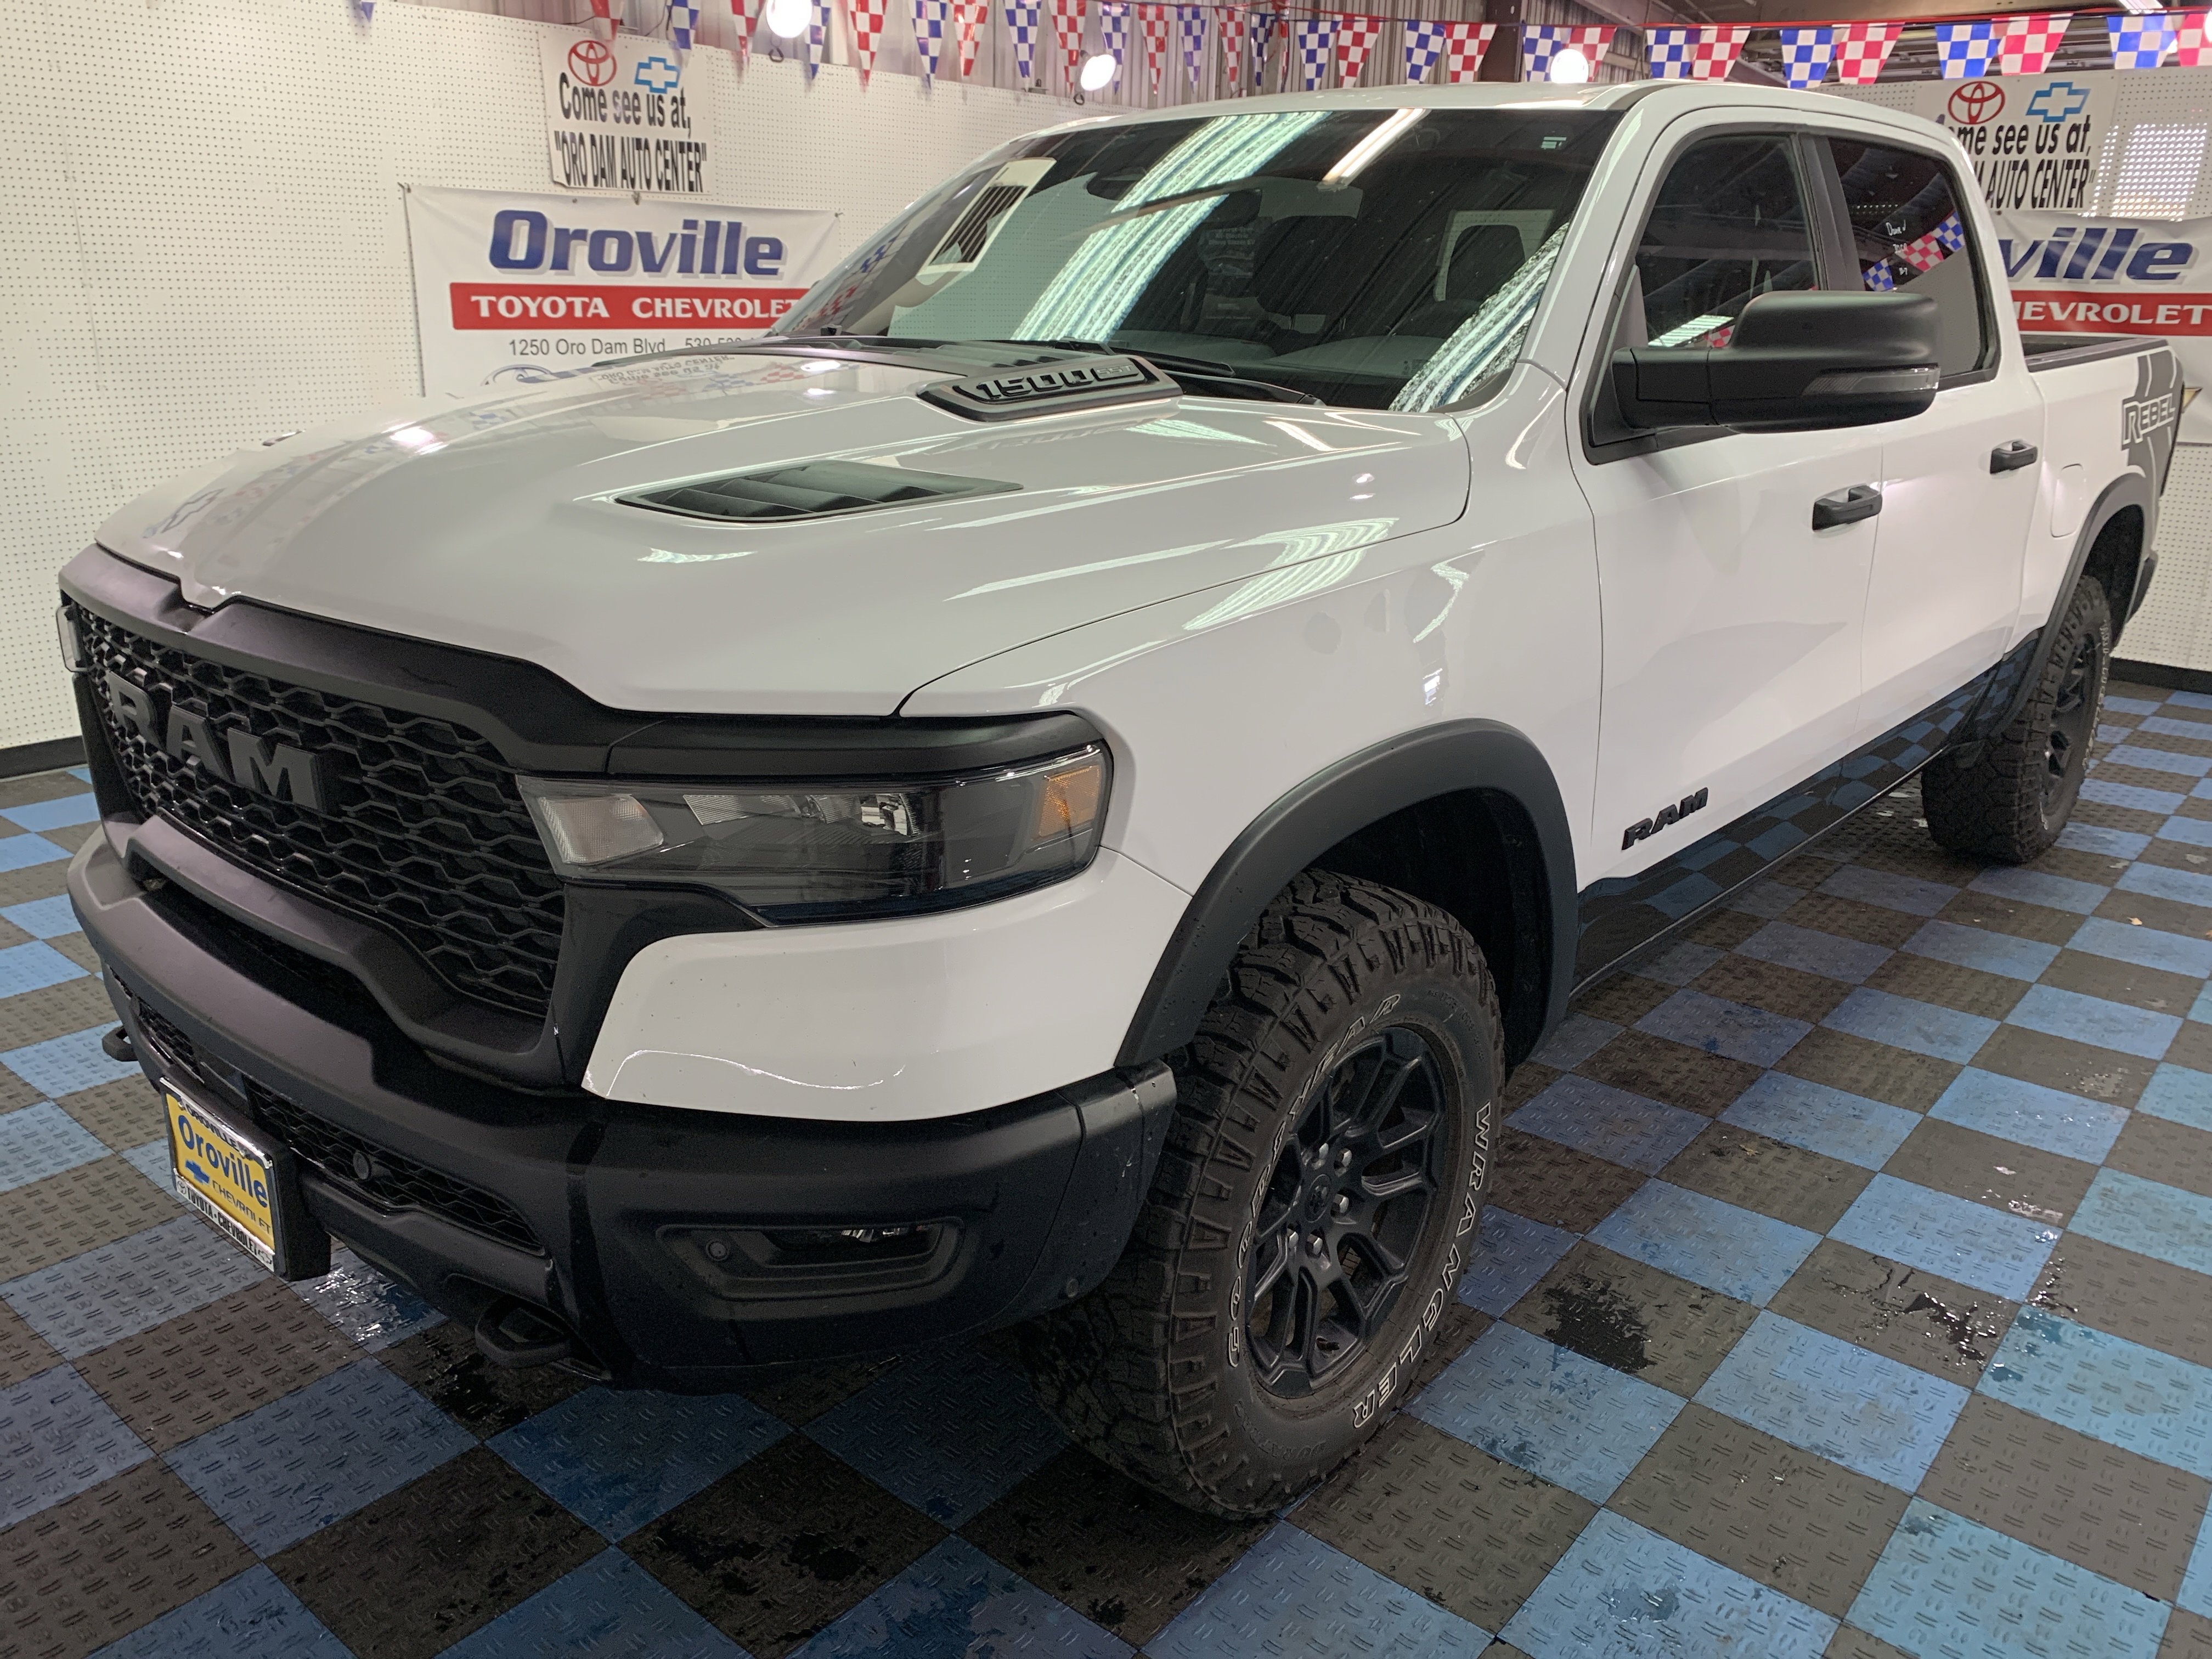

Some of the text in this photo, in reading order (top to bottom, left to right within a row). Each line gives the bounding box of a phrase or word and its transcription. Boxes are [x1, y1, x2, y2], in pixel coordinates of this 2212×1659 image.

[558, 72, 691, 138] Come see us at,
[1992, 124, 2029, 155] see
[2035, 123, 2061, 154] us
[2066, 114, 2091, 156] at,
[554, 130, 707, 193] "ORO DAM AUTO CENTER"
[1985, 158, 2029, 210] AUTO
[2031, 158, 2097, 209] CENTER"
[488, 210, 786, 278] Oroville
[471, 295, 610, 319] TOYOTA
[2013, 301, 2212, 325] EVROLET
[509, 338, 549, 356] 1250
[556, 338, 586, 356] Oro
[592, 338, 628, 355] Dam
[634, 337, 665, 354] Blvd
[977, 367, 1096, 399] 1500
[2123, 392, 2176, 444] REBEL
[108, 670, 325, 812] RAM
[1621, 787, 1708, 850] RAM
[178, 1114, 268, 1208] Oroville
[187, 1186, 213, 1219] TOYOTA
[1353, 1101, 1491, 1428] WRANGLER
